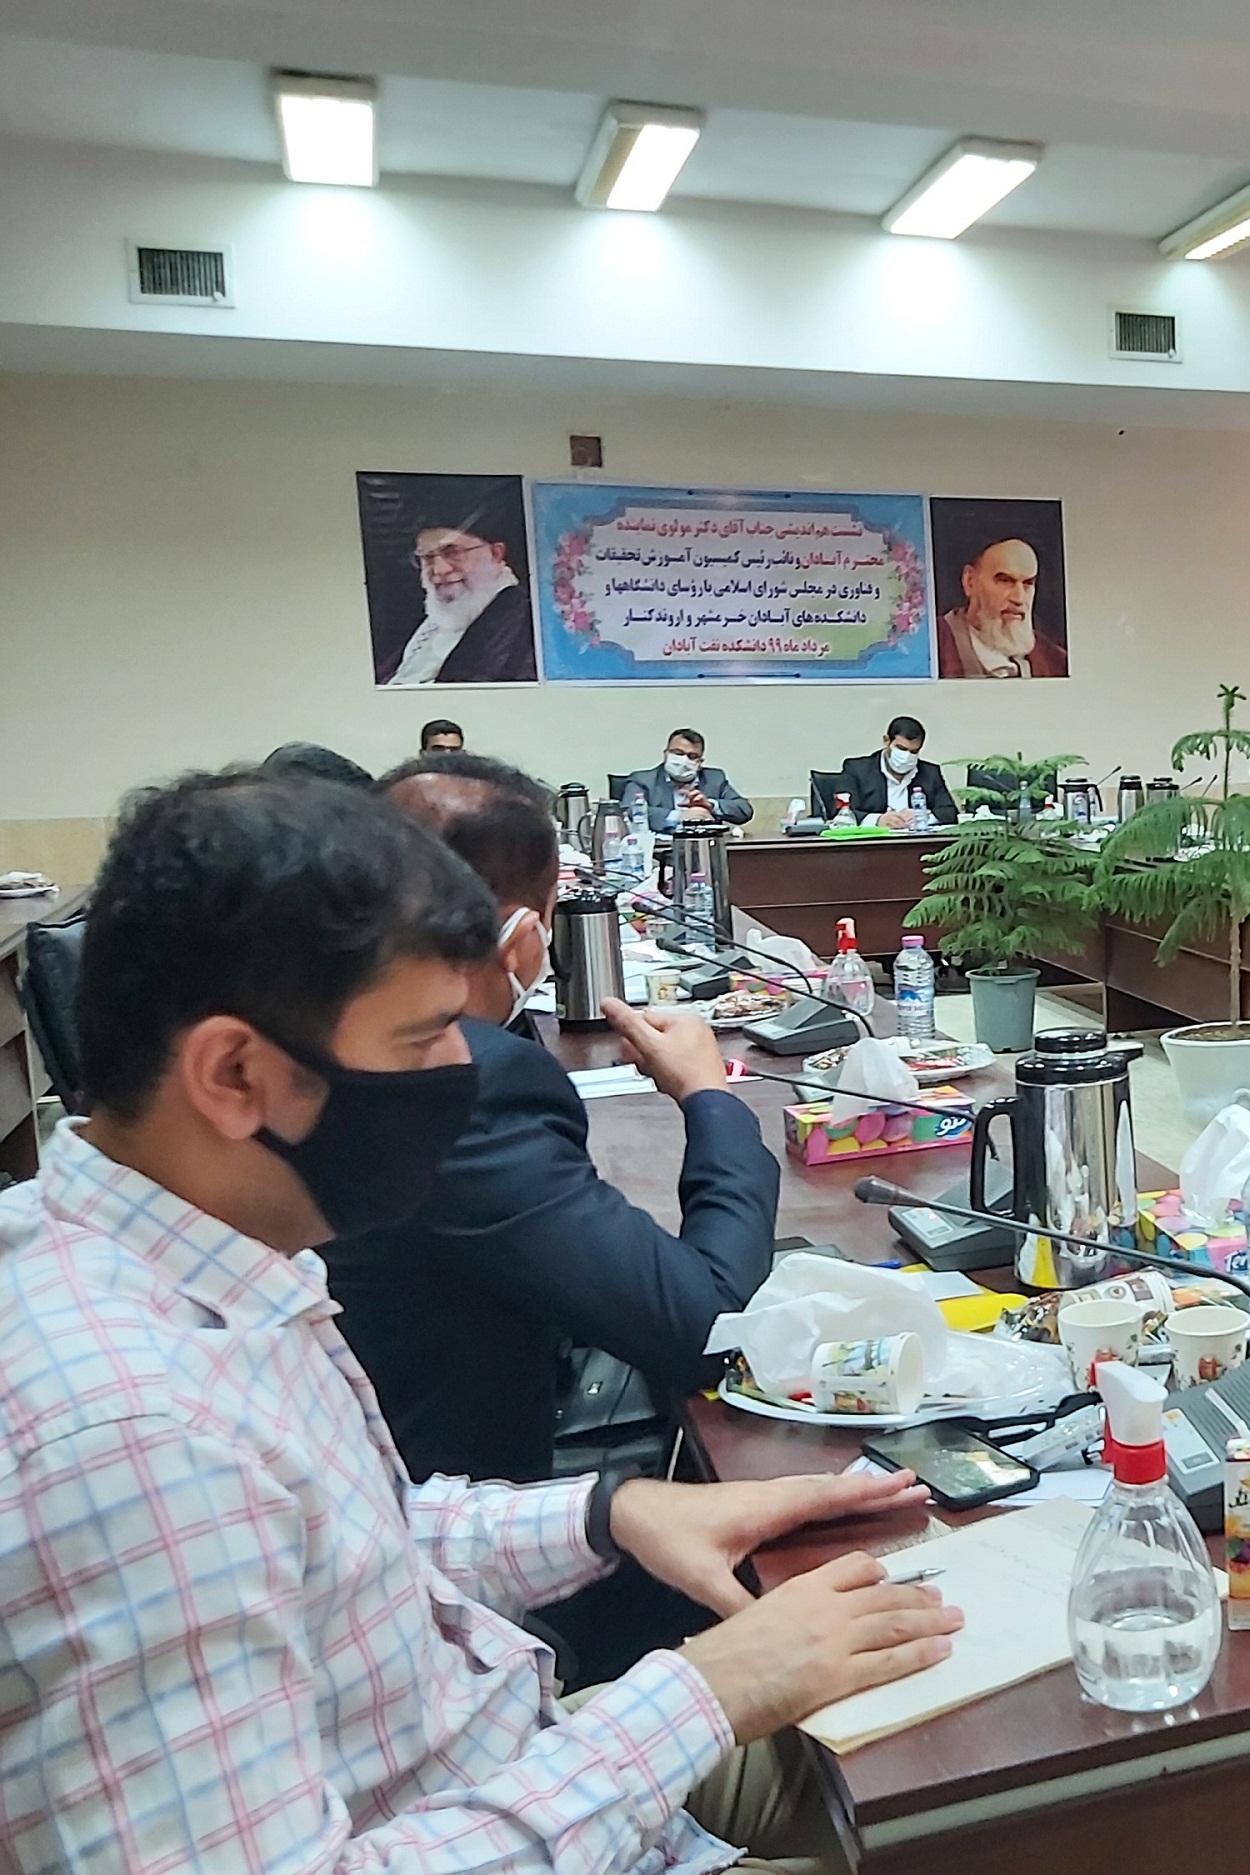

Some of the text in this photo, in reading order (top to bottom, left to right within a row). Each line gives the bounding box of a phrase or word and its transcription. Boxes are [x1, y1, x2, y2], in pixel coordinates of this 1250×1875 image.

[617, 517, 655, 535] نماینده
[657, 519, 691, 537] مولوی
[694, 520, 717, 537] دکتر
[719, 518, 743, 538] آقای
[746, 521, 775, 539] جناب
[831, 523, 863, 537] نشست
[595, 547, 640, 565] تحقیقات
[641, 547, 692, 567] آموزش
[693, 549, 740, 568] کمیسیون
[801, 550, 842, 569] آبادان
[843, 554, 884, 570] محترم
[605, 582, 611, 596] و
[612, 577, 665, 595] دانشگاهها
[667, 578, 702, 597] رؤسای
[714, 578, 751, 597] اسلامی
[754, 579, 787, 599] شورای
[789, 580, 823, 598] مجلس
[825, 584, 837, 599] در
[839, 580, 873, 599] فناوری
[695, 609, 746, 627] خرمشهر
[749, 608, 790, 627] آبادان
[663, 637, 830, 656] مرداد ماه ۹۹ دانشکده نفت آبادان
